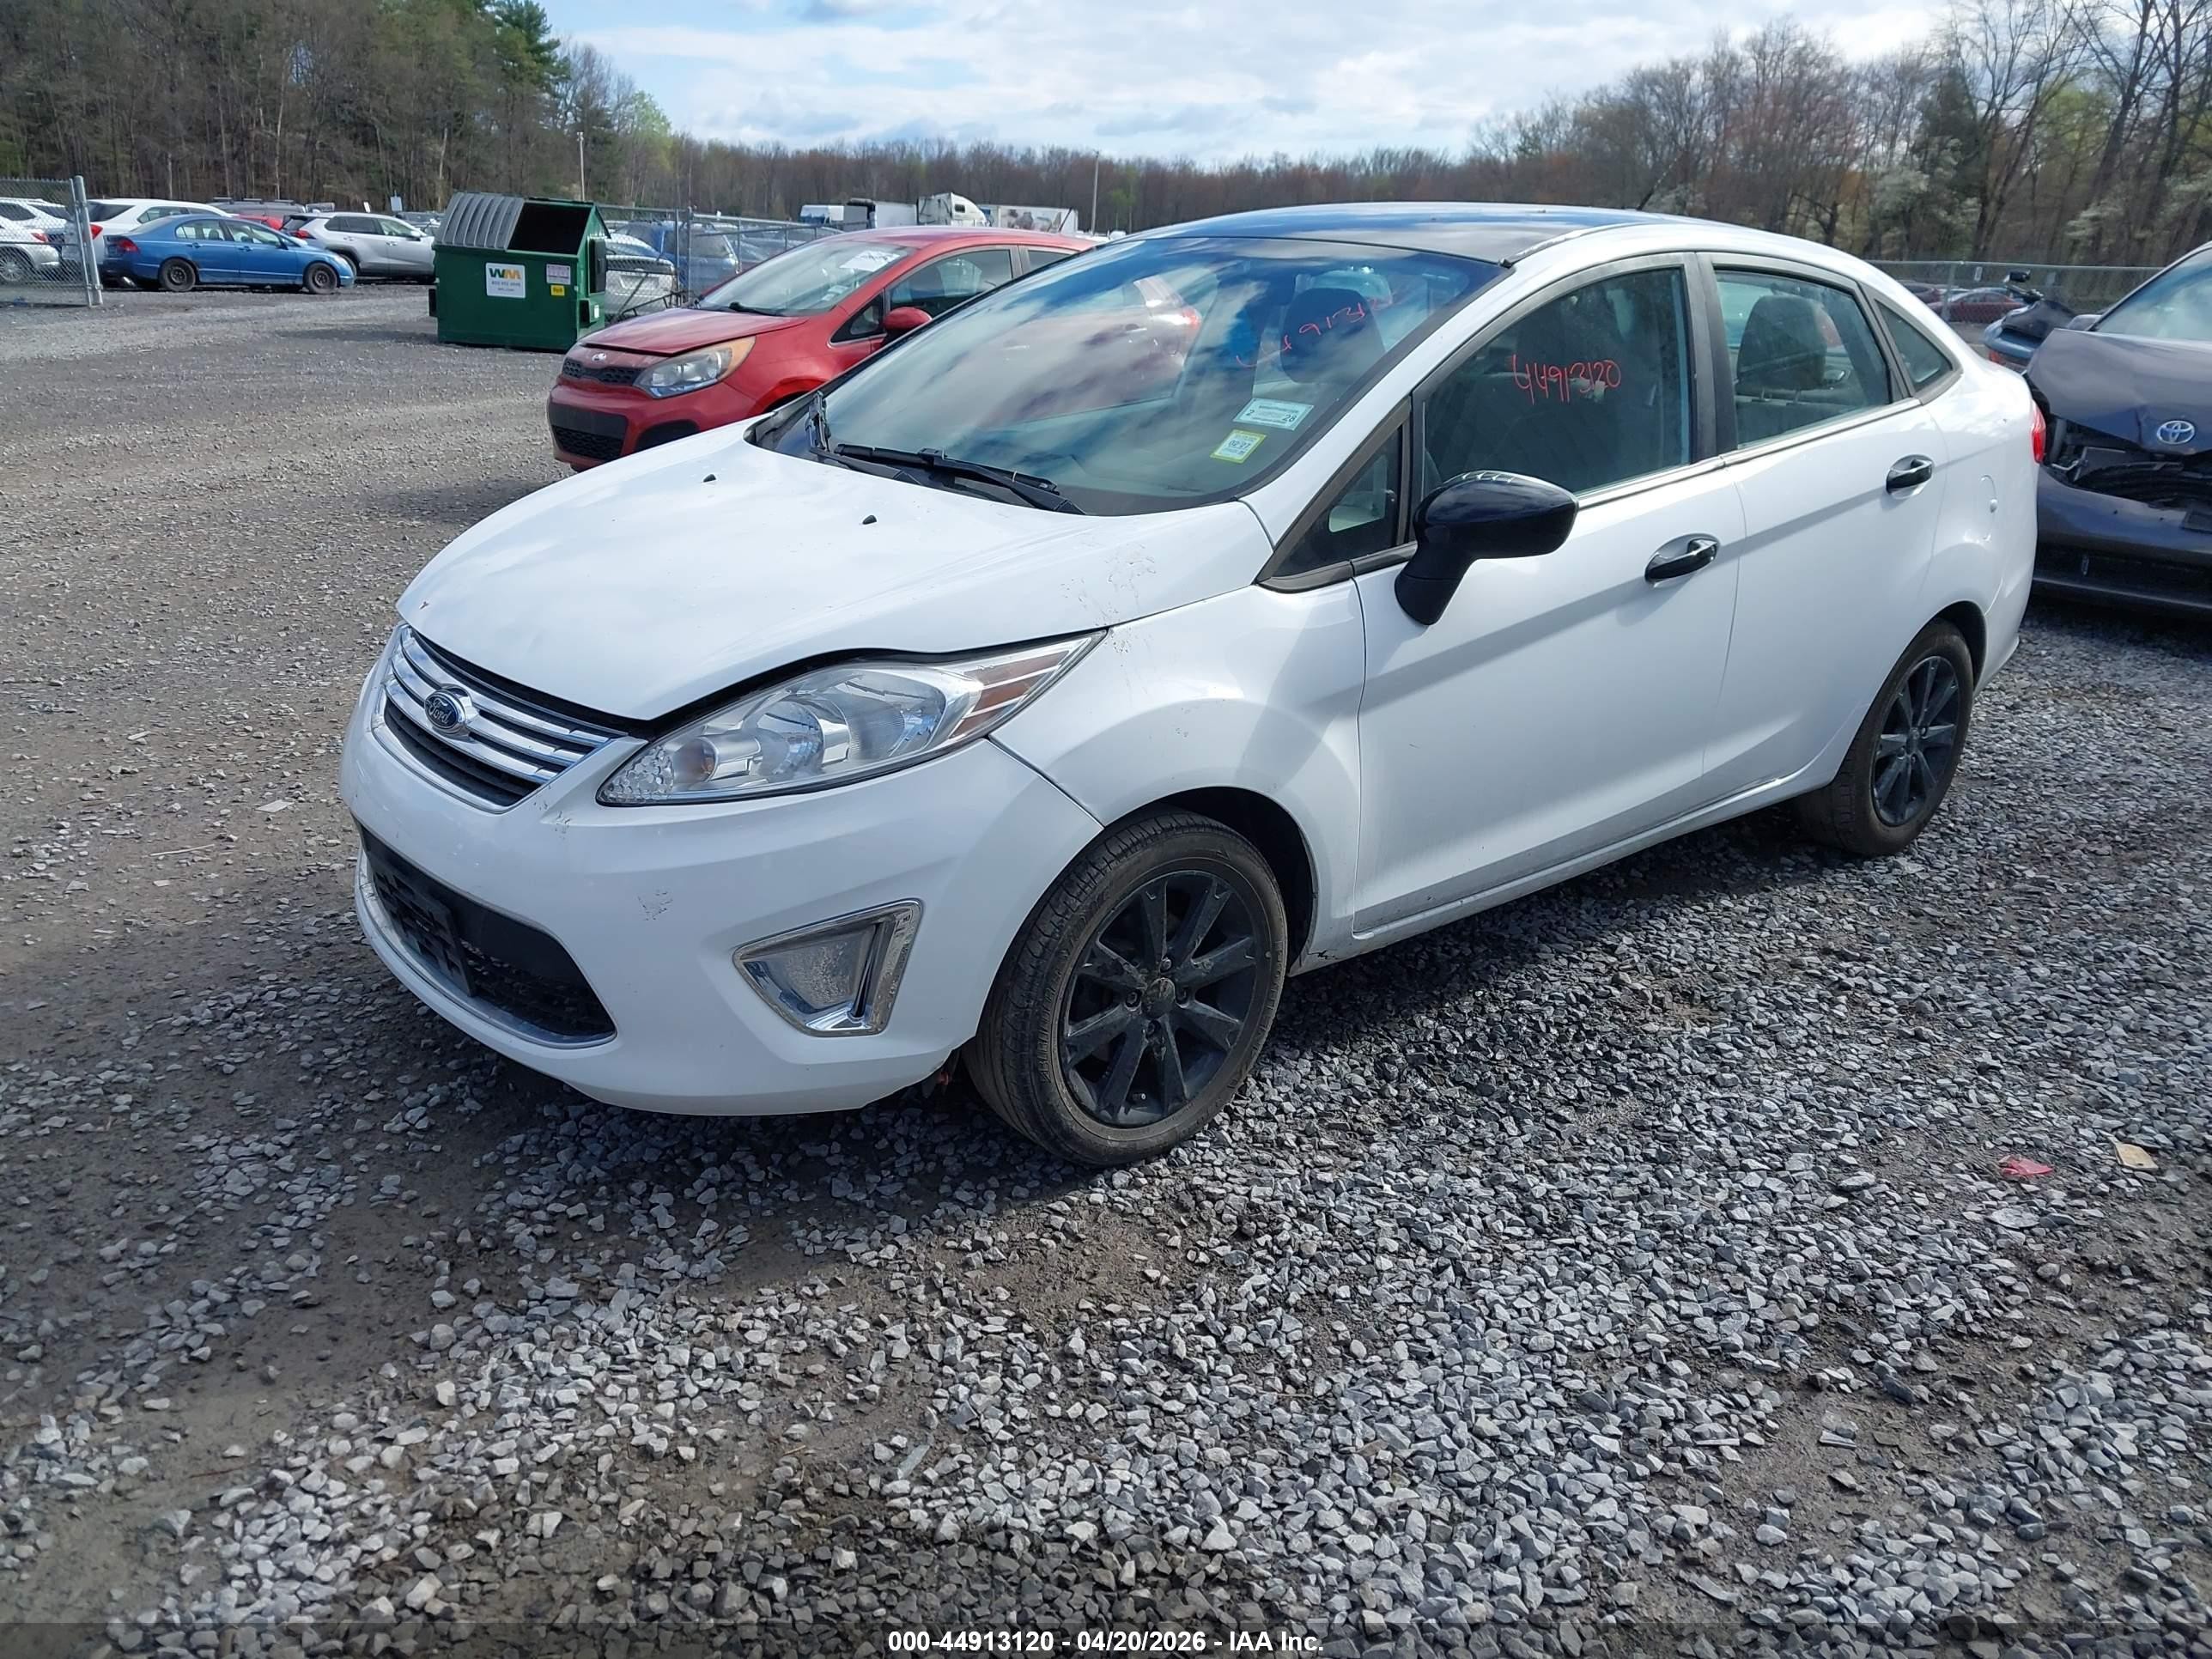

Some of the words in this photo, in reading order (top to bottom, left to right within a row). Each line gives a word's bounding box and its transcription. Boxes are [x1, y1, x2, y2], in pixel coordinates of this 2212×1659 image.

[489, 268, 521, 280] WM
[1512, 354, 1622, 405] 44913120
[429, 698, 452, 724] Ford
